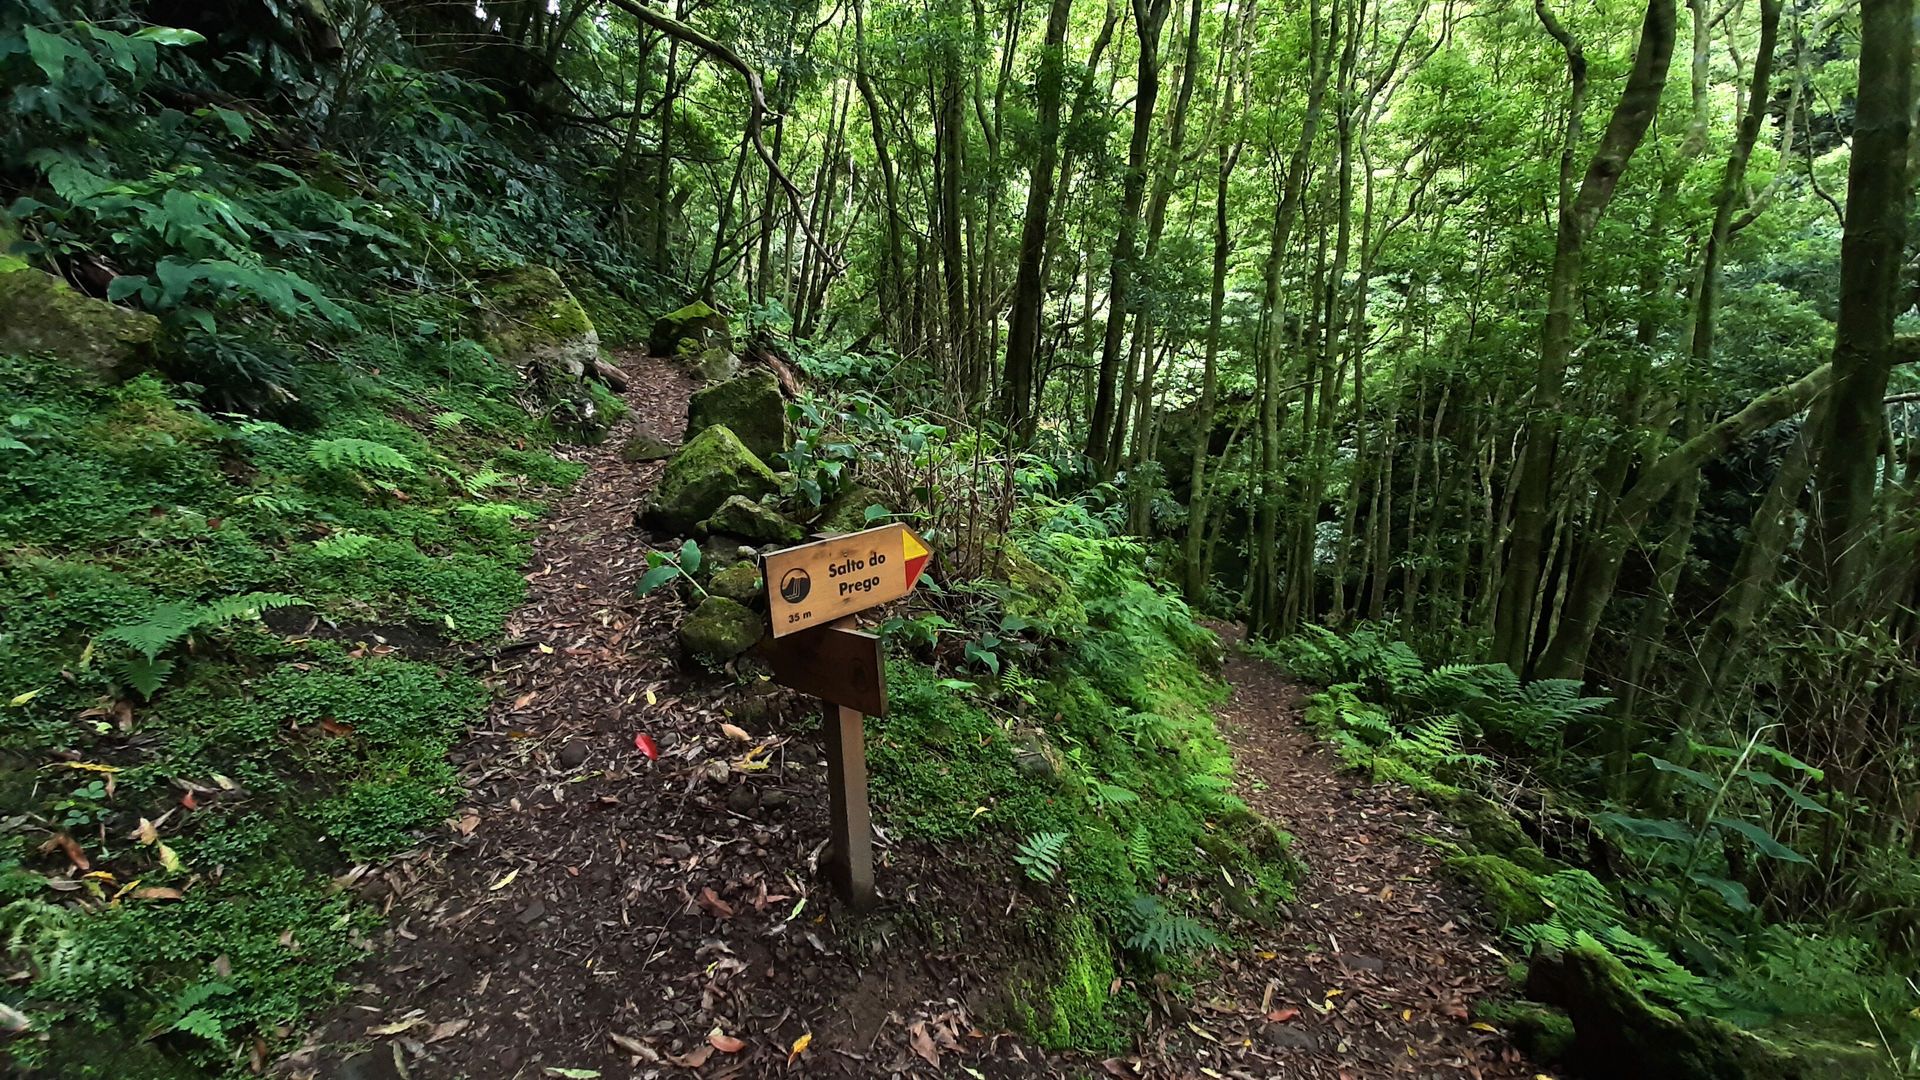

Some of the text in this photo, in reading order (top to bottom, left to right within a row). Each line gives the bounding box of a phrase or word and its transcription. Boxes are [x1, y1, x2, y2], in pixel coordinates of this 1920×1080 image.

[828, 552, 886, 578] Salto do
[839, 576, 880, 596] Prego
[788, 611, 812, 624] 35 m
